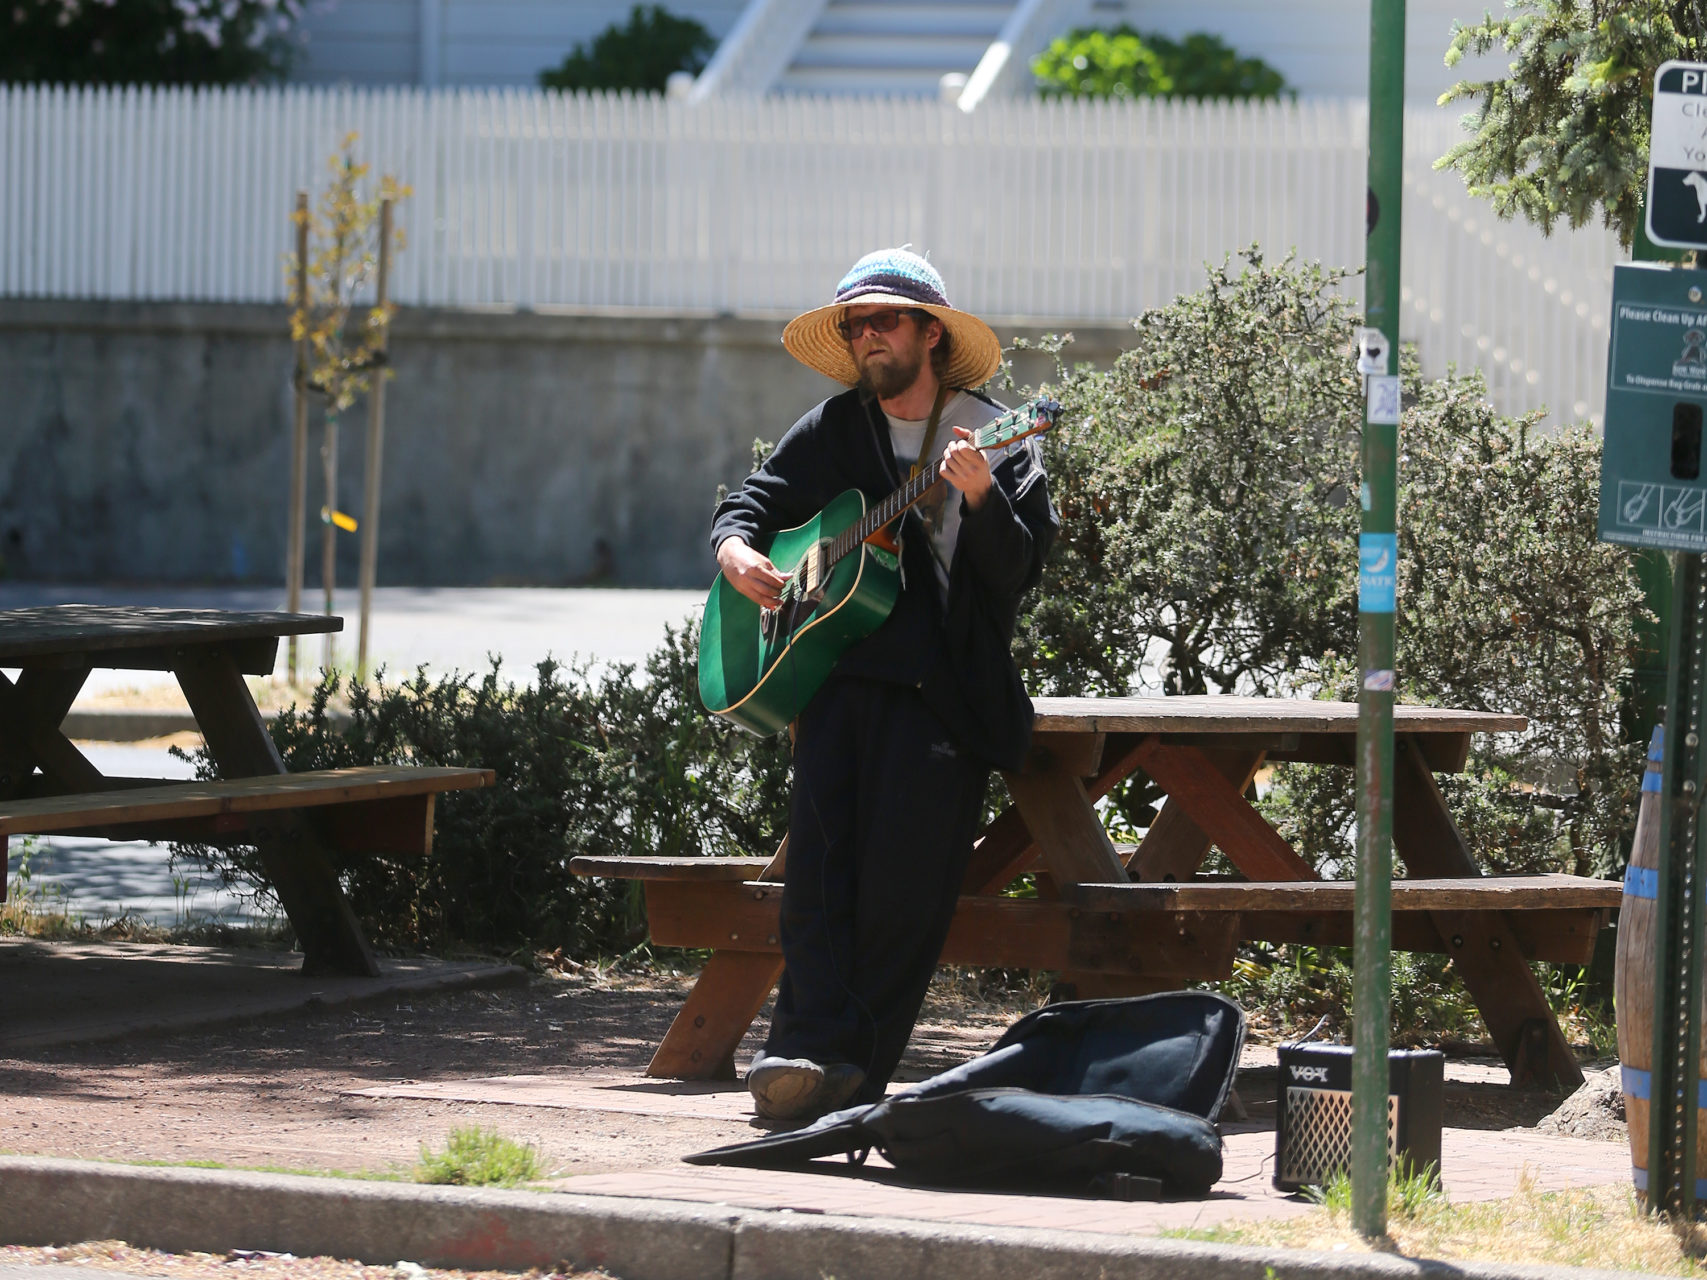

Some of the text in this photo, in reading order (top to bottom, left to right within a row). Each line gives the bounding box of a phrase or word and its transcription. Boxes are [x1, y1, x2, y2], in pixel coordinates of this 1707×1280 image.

[1619, 306, 1651, 322] Please
[1652, 310, 1680, 325] Clean
[1681, 314, 1695, 327] Up
[1289, 1064, 1328, 1083] VOX
